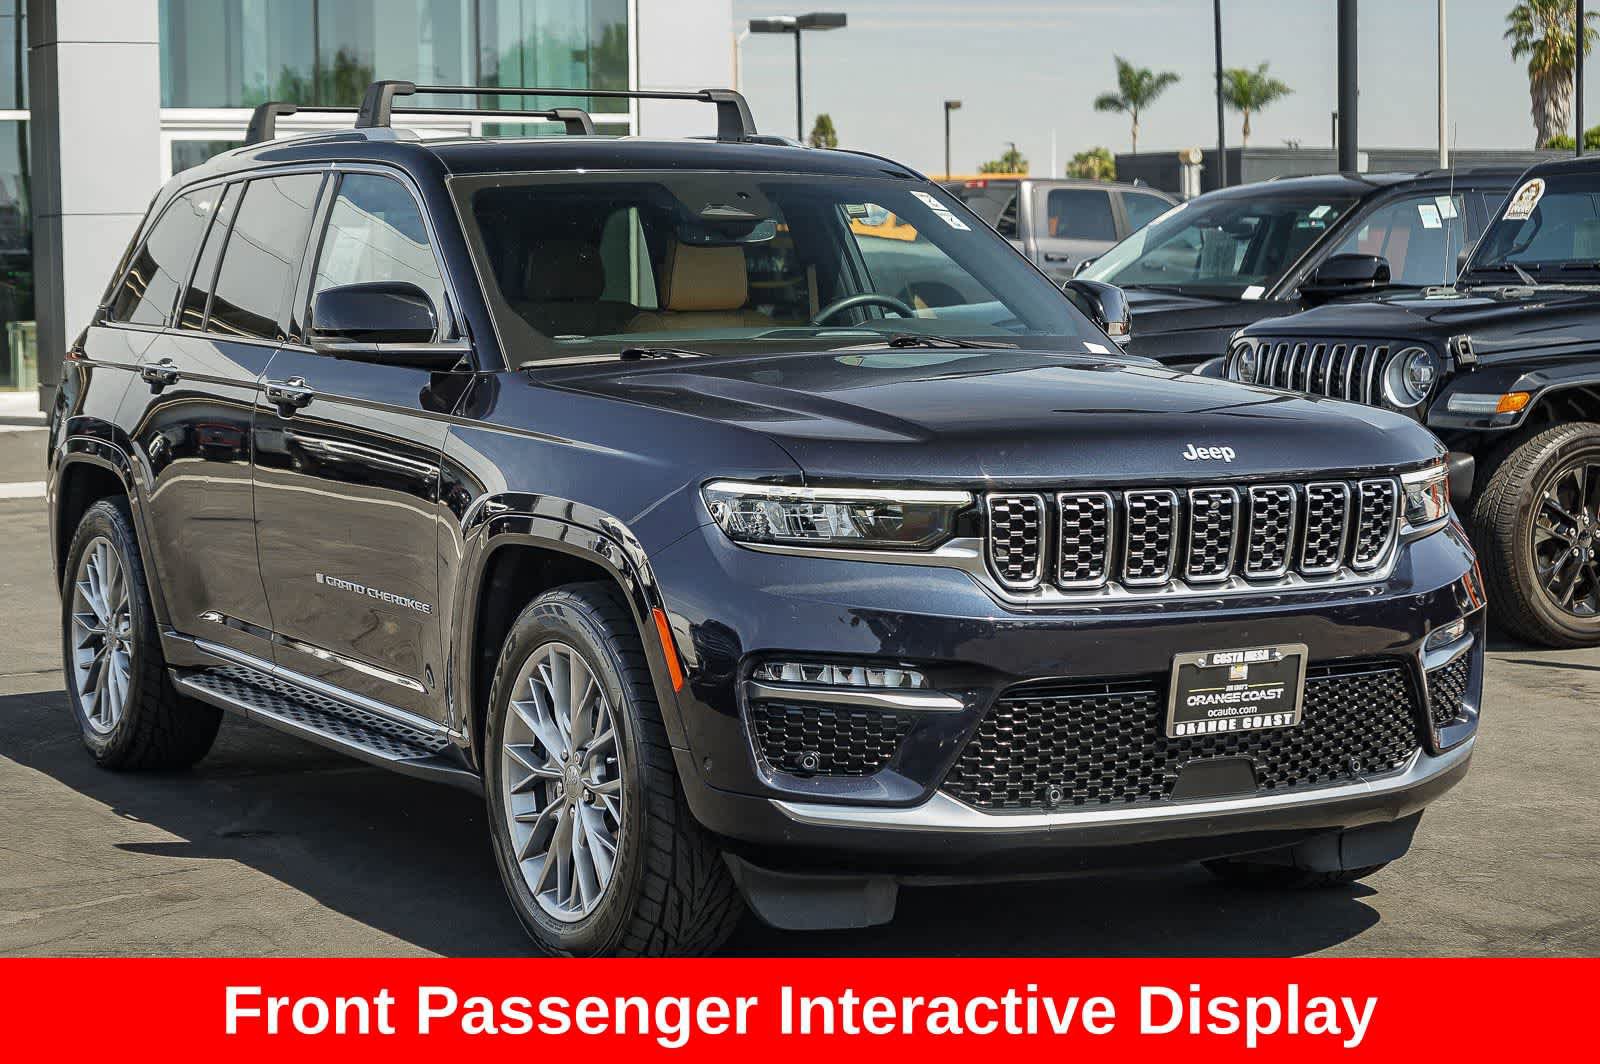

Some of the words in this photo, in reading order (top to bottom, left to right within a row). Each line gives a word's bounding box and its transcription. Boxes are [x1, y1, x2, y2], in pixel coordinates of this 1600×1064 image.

[1183, 444, 1235, 462] Jeep
[326, 576, 365, 594] GRAND
[367, 588, 431, 613] CHEROKEE
[1213, 652, 1244, 664] COSTA
[1187, 692, 1240, 706] ORANGE
[1242, 688, 1284, 701] COAST
[1207, 706, 1257, 717] ocauto.com
[1176, 719, 1236, 735] ORANGE
[1242, 714, 1292, 728] COAST
